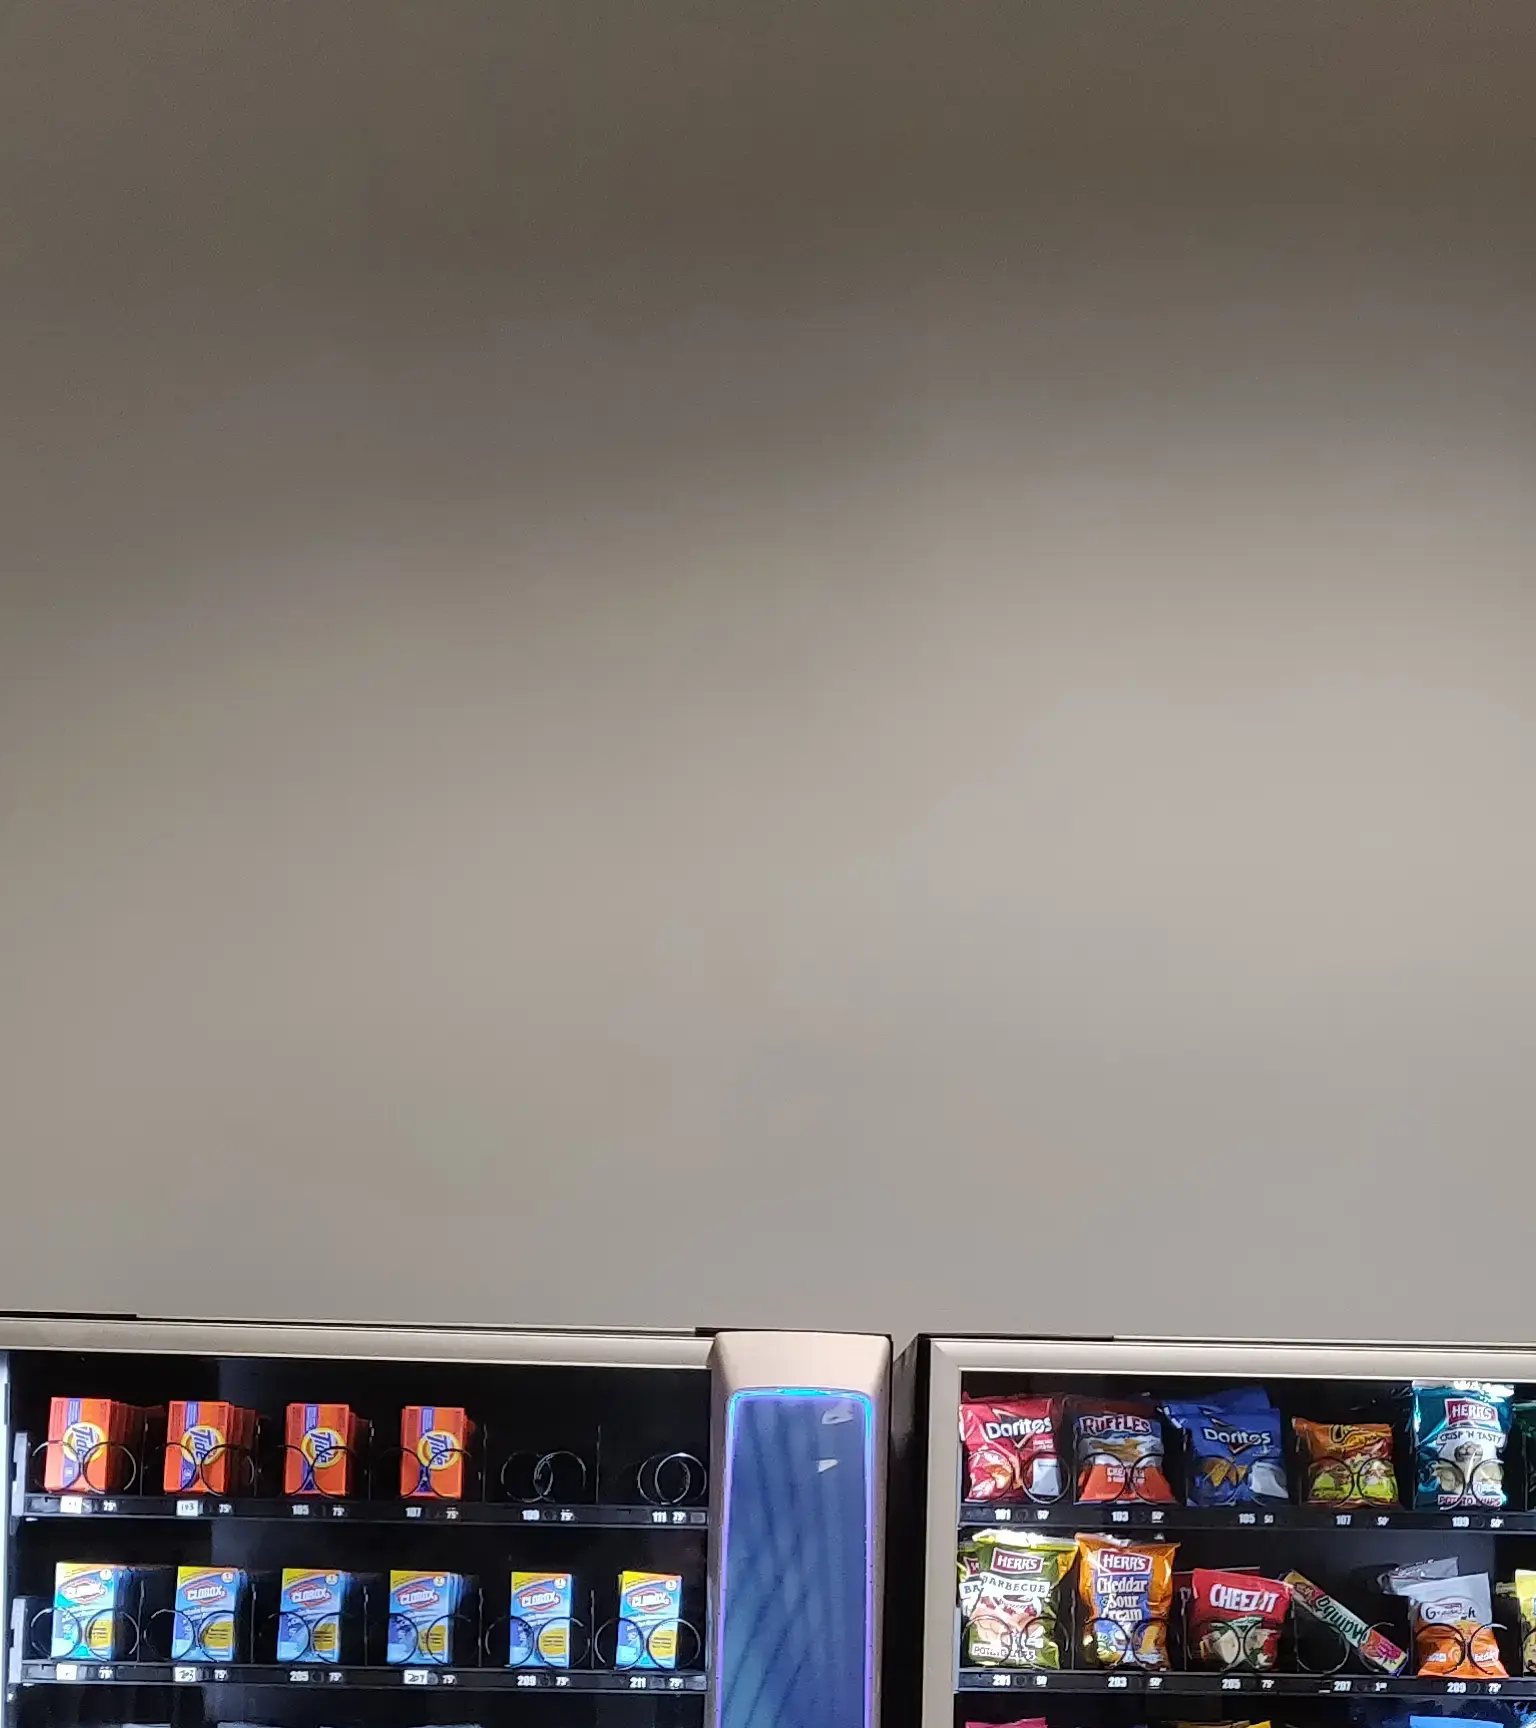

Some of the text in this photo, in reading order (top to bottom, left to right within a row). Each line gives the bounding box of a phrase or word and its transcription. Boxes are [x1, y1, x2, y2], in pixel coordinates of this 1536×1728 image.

[984, 1416, 1052, 1441] Doritos
[1078, 1414, 1152, 1436] RUFFLES
[1203, 1427, 1271, 1445] Doritos
[1440, 1430, 1464, 1443] CRISP
[1477, 1431, 1503, 1444] TASTY
[996, 1556, 1039, 1571] HERR'S
[1102, 1554, 1147, 1571] HERR'S
[982, 1574, 1046, 1593] BARBECUE
[1096, 1575, 1148, 1594] Cheddar
[1108, 1594, 1139, 1608] Sour
[630, 1677, 646, 1688] 211
